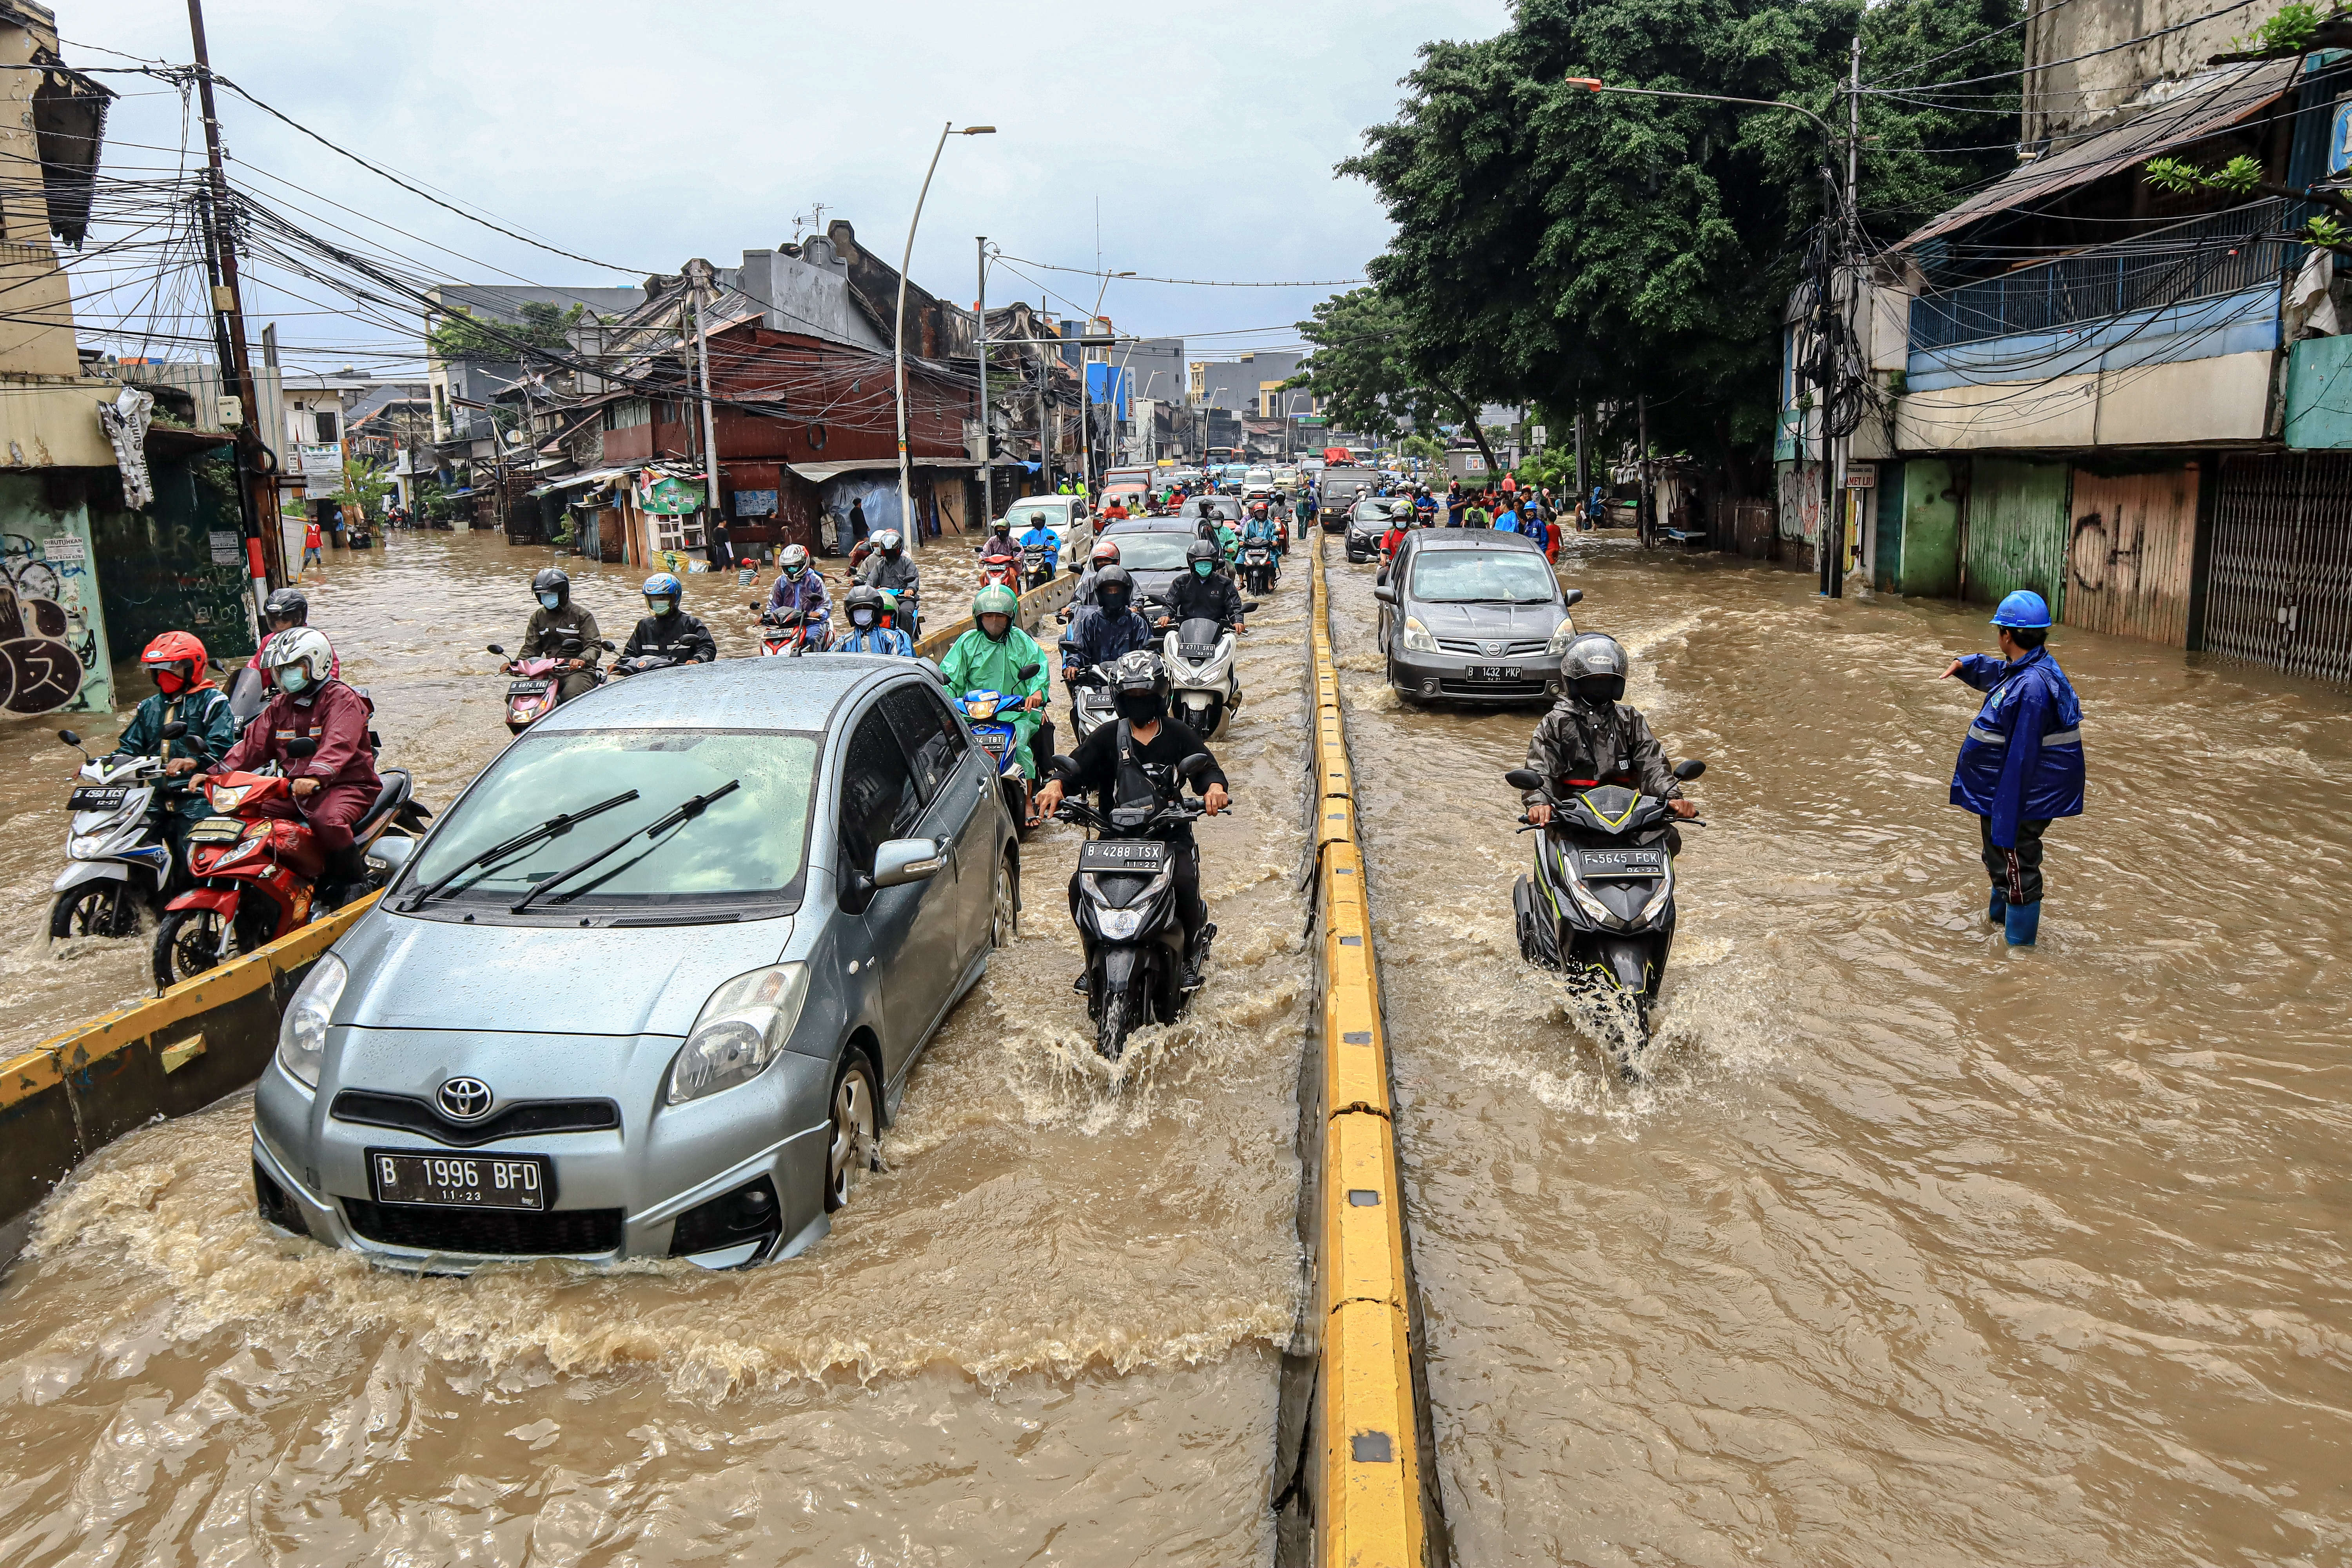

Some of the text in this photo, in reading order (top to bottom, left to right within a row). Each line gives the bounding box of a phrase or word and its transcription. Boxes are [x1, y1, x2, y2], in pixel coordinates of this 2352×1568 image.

[1863, 477, 1873, 485] LIU
[1468, 667, 1521, 677] B 1432 PKP
[106, 789, 123, 797] KCS
[1087, 846, 1160, 858] B 4288 TSX
[1585, 853, 1658, 864] F 5645 FCK
[381, 1156, 538, 1190] B 1996 BFD
